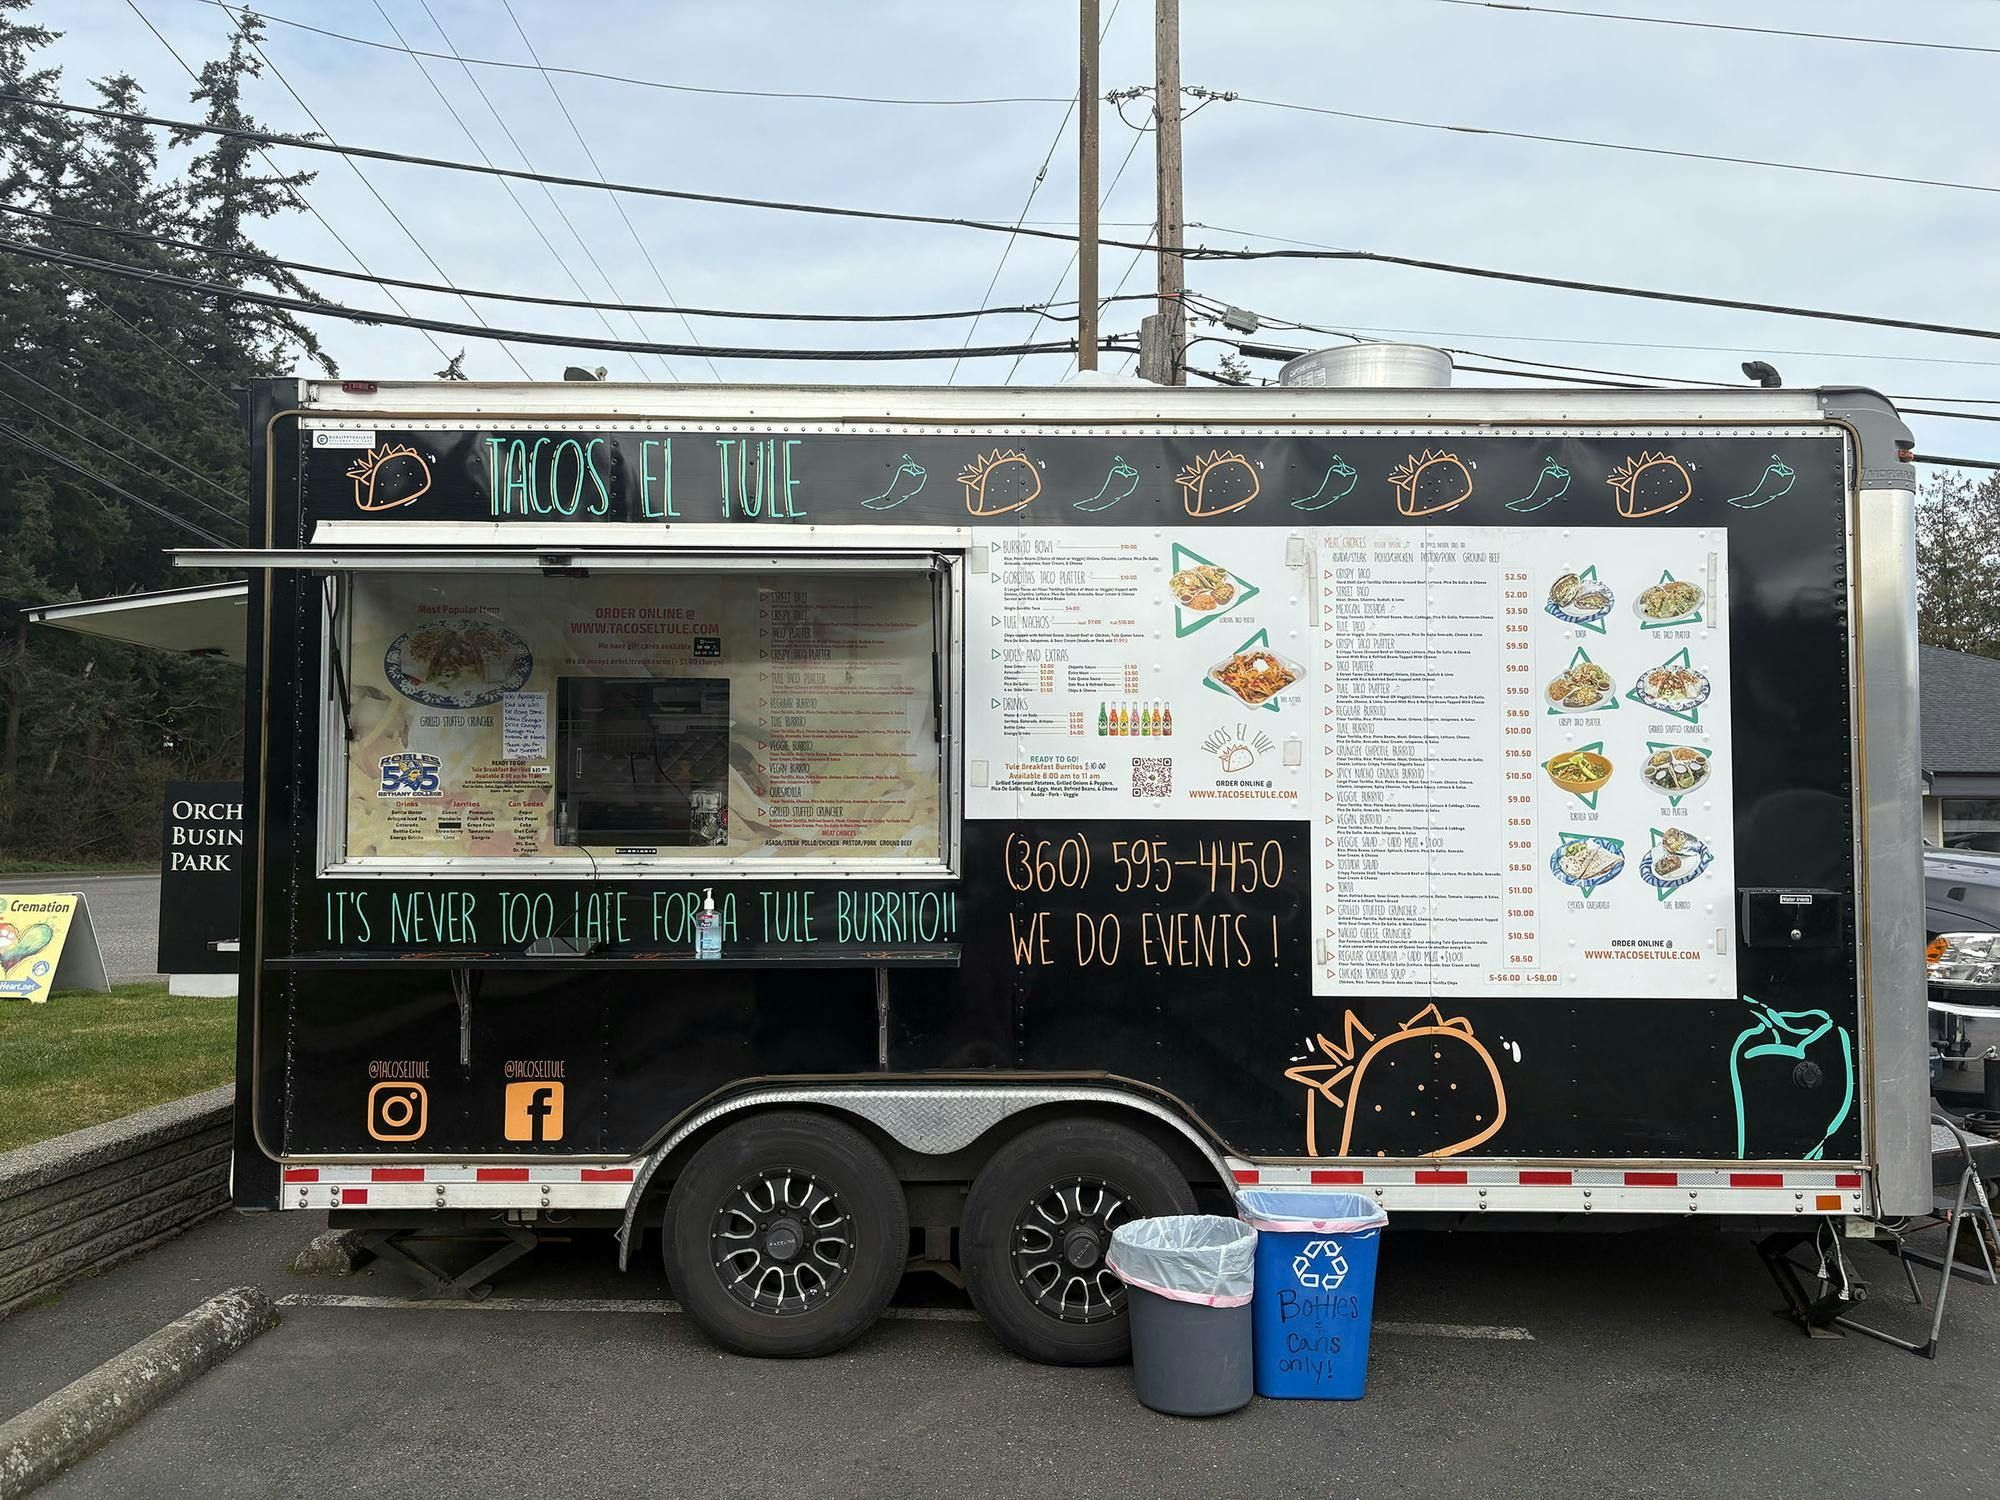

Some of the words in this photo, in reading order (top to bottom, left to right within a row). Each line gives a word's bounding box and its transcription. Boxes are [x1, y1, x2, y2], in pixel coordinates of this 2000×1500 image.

[485, 437, 610, 516] TACOS
[640, 438, 681, 517] EL
[716, 439, 807, 518] TULE
[1003, 540, 1031, 553] BURRITO
[1035, 540, 1053, 553] BOWL
[1040, 571, 1055, 584] TACO
[1060, 571, 1085, 584] PLATTER
[1505, 573, 1527, 581] $2.50
[1505, 591, 1527, 599] $2.00
[418, 605, 440, 614] Most
[443, 605, 477, 615] Popular
[480, 606, 500, 614] Item
[595, 608, 635, 618] ORDER
[639, 608, 682, 619] ONLINE
[686, 609, 695, 619] @
[1506, 607, 1528, 615] $3.50
[571, 622, 720, 634] WWW.TACOSELTULE.COM
[1003, 616, 1017, 629] TULE
[1022, 616, 1050, 629] NACHOS
[1506, 642, 1528, 650] $9.50
[1003, 649, 1021, 662] SIDES
[1026, 649, 1041, 661] AND
[1045, 649, 1069, 661] EXTRAS
[1506, 687, 1529, 695] $9.50
[1003, 697, 1028, 710] DRINKS
[1506, 709, 1529, 717] $8.50
[1505, 727, 1531, 735] $10.00
[1201, 725, 1232, 754] TACOS
[1236, 723, 1247, 741] EL
[1251, 730, 1276, 757] TULE
[380, 754, 441, 766] ROBLES
[1506, 772, 1532, 780] $10.50
[1189, 791, 1298, 799] WWW.TACOSELTULE.COM
[1508, 818, 1531, 826] $8.50
[1509, 841, 1531, 849] $9.00
[1005, 832, 1091, 892] (360)
[1112, 839, 1283, 892] 595-4450
[1509, 864, 1531, 872] $8.50
[10, 900, 70, 913] Cremation
[1338, 904, 1360, 916] GRILLED
[1363, 904, 1385, 916] STUFFED
[1388, 904, 1417, 916] CRUNCHER
[327, 891, 371, 944] IT'S
[392, 892, 477, 944] NEVER
[499, 892, 554, 944] TOO
[653, 891, 700, 943] FOR
[723, 892, 738, 942] A
[759, 891, 818, 943] TULE
[838, 891, 956, 943] BURRITO!!
[1508, 909, 1534, 917] $10.00
[1338, 928, 1357, 939] NACHO
[1360, 928, 1379, 939] CHEESE
[1382, 928, 1412, 939] CRUNCHER
[1508, 932, 1534, 940] $10.50
[1010, 912, 1054, 965] WE
[1076, 912, 1121, 966] DO
[1142, 912, 1251, 969] EVENTS
[1611, 940, 1636, 948] ORDER
[1637, 940, 1664, 948] ONLINE
[1666, 940, 1673, 949] @
[1510, 955, 1533, 963] $8.50
[1584, 951, 1700, 961] WWW.TACOSELTULE.COM
[1489, 974, 1520, 982] S-$6.00
[1527, 974, 1557, 982] L-$8.00
[368, 1060, 431, 1078] @TACOSELTULE
[504, 1060, 565, 1078] @TACOSELTULE
[1277, 1289, 1359, 1323] Bottles
[1287, 1332, 1341, 1354] Cans
[1279, 1358, 1333, 1385] only!
